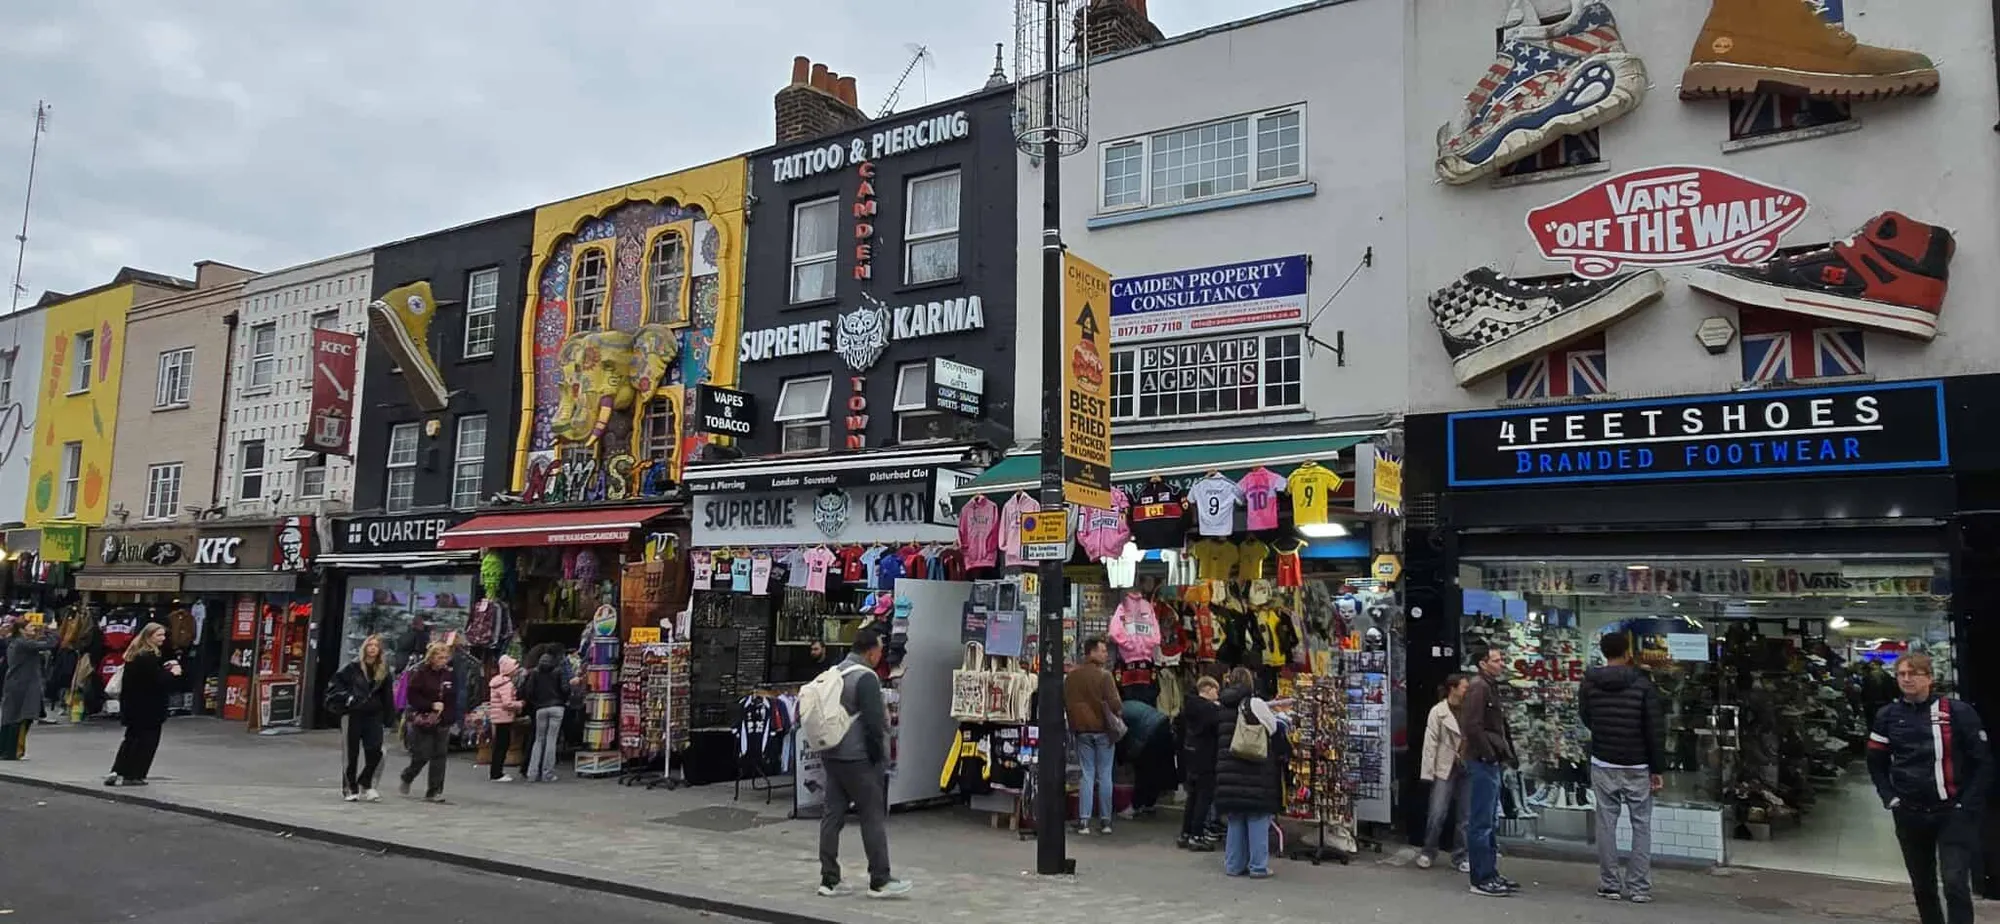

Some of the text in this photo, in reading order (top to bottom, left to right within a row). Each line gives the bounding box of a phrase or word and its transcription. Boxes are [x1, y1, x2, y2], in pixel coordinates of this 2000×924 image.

[772, 110, 969, 182] TATTOO & PIERCING
[1606, 172, 1702, 215] VANS
[853, 161, 877, 280] CAMDEN
[1616, 208, 1686, 252] THE
[1068, 266, 1107, 294] CHICKEN
[1111, 262, 1285, 298] CAMDEN PROPERTY
[1131, 283, 1263, 312] CONSULTANCY
[740, 295, 985, 363] SUPREME KARMA
[320, 341, 352, 356] KFC
[1141, 338, 1258, 369] ESTATE
[1141, 363, 1256, 393] AGENTS
[714, 390, 744, 408] VAPES
[724, 406, 732, 418] &
[845, 376, 869, 449] TOWN
[1070, 389, 1106, 419] BEST
[705, 415, 750, 433] TOBACCO
[1070, 411, 1106, 439] FRIED
[1070, 431, 1106, 452] CHICKEN
[1070, 443, 1106, 462] IN LONDON
[1685, 437, 1861, 467] FOOTWEAR
[771, 474, 837, 487] London Souvenir
[870, 469, 911, 482] Disturbed
[1209, 496, 1220, 516] 9
[1250, 490, 1268, 511] 10
[1304, 485, 1314, 507] 9
[704, 498, 795, 529] SUPREME
[193, 537, 243, 564] KFC
[1800, 572, 1852, 590] VANS
[1513, 657, 1584, 683] SALE
